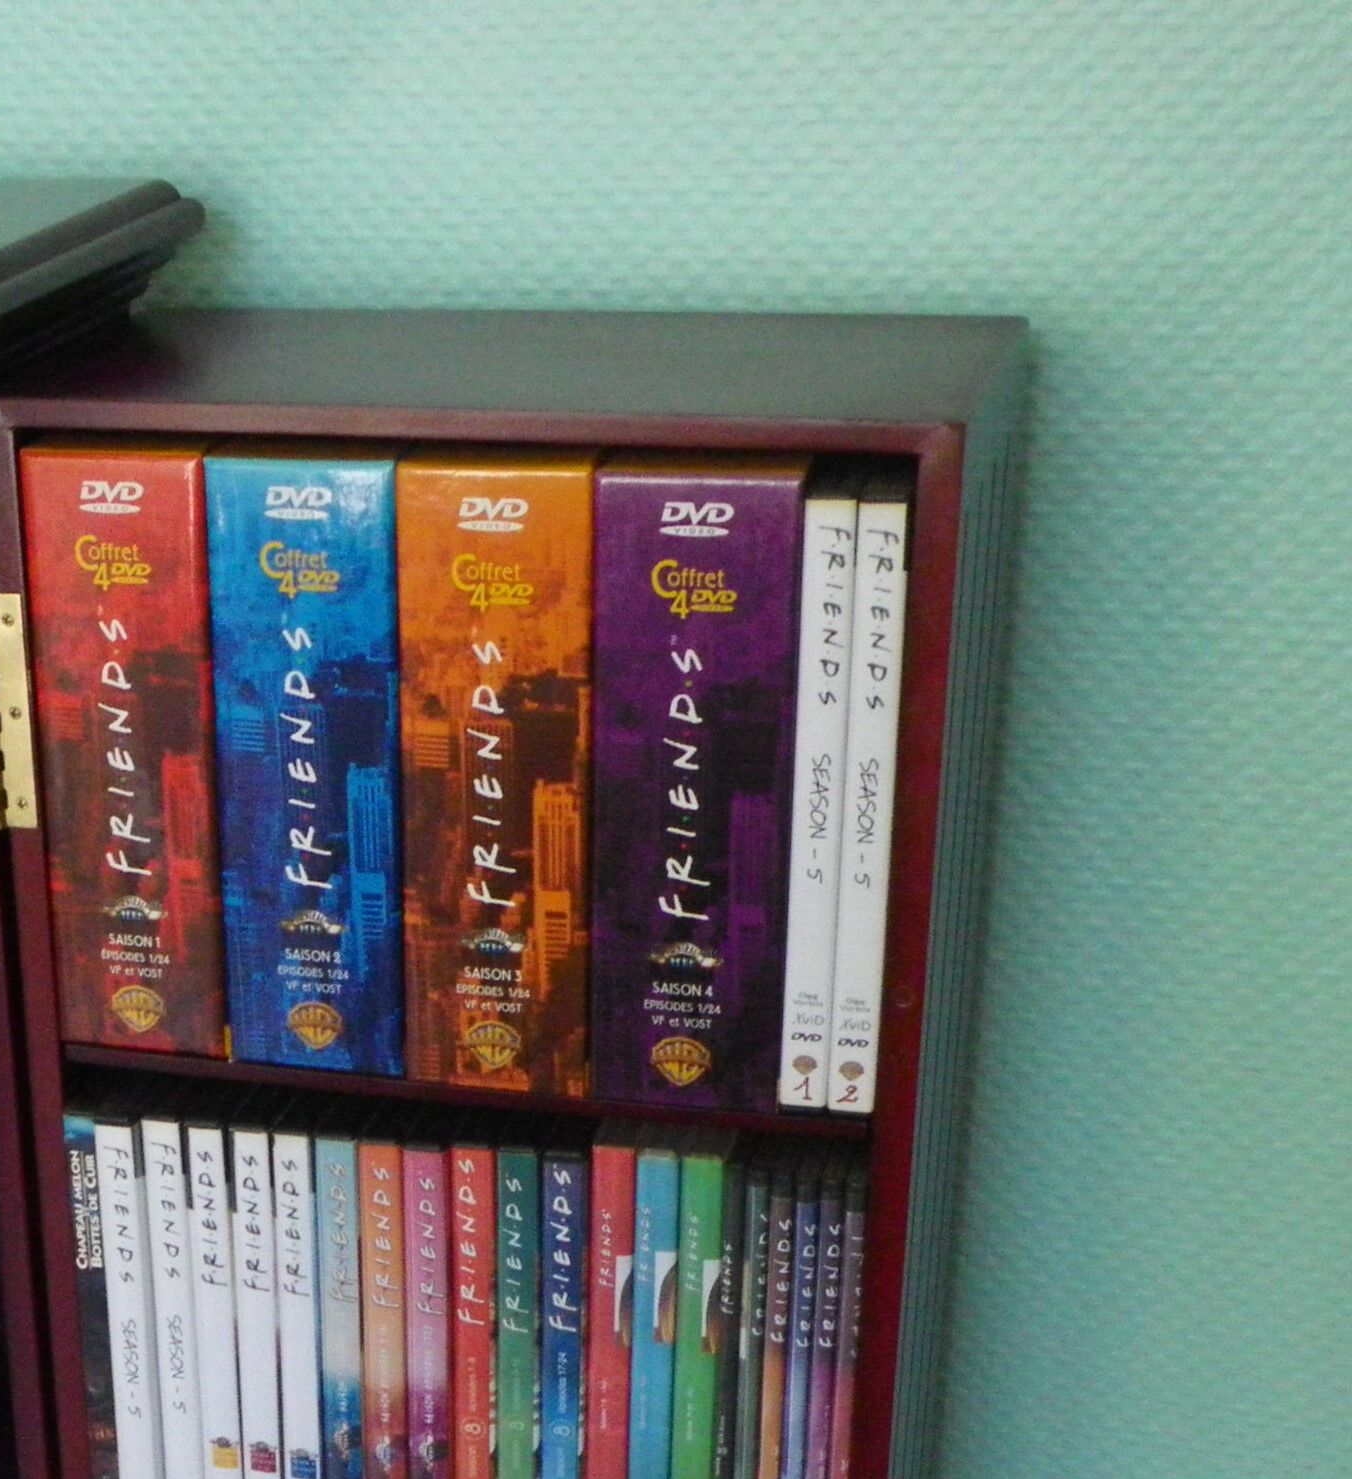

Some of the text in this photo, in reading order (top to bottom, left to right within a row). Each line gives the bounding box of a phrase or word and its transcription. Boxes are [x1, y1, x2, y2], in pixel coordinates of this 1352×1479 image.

[79, 480, 144, 502] DVD
[265, 486, 332, 508] DVD
[458, 497, 529, 520] DVD
[661, 501, 734, 524] DVD
[73, 535, 139, 579] Coffret
[259, 542, 328, 579] Coffret
[451, 554, 521, 593] Coffret
[651, 559, 725, 598] Coffret
[809, 753, 832, 842] SEASON
[858, 758, 881, 846] SEASON
[108, 931, 161, 949] SAISON 1
[284, 947, 341, 965] SAISON 2
[464, 965, 522, 983] SAISON 3
[651, 980, 713, 998] SAISON 4
[835, 1086, 859, 1104] 2
[83, 1154, 96, 1188] CUIR
[68, 1150, 88, 1270] CHAPEAU MELON
[89, 1220, 102, 1269] BOTTES
